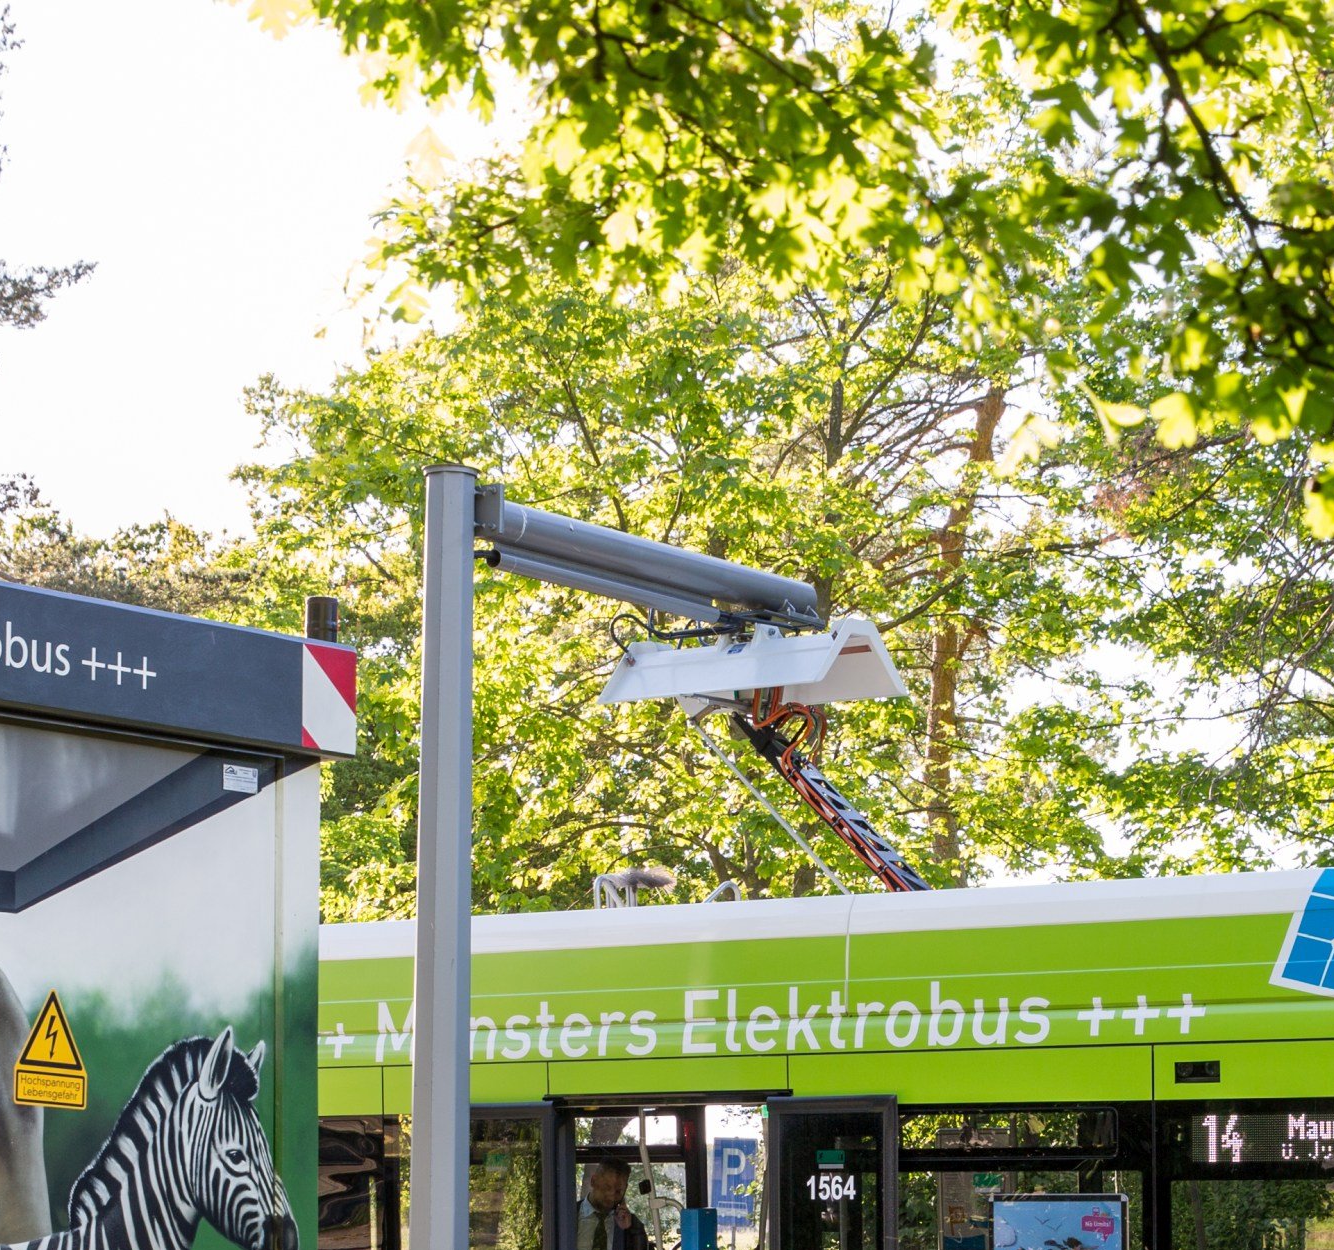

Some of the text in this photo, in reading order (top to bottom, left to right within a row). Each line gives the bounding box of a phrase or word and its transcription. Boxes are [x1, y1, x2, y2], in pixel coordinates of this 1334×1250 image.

[81, 646, 158, 691] +++
[374, 1000, 658, 1063] Mnsters
[680, 980, 1051, 1055] Elektrobus
[1076, 992, 1207, 1037] +++
[20, 1074, 81, 1092] Hochspannung
[22, 1086, 78, 1101] Lebensgefahr
[1202, 1114, 1243, 1163] 14
[721, 1147, 747, 1197] P
[806, 1174, 857, 1201] 1564
